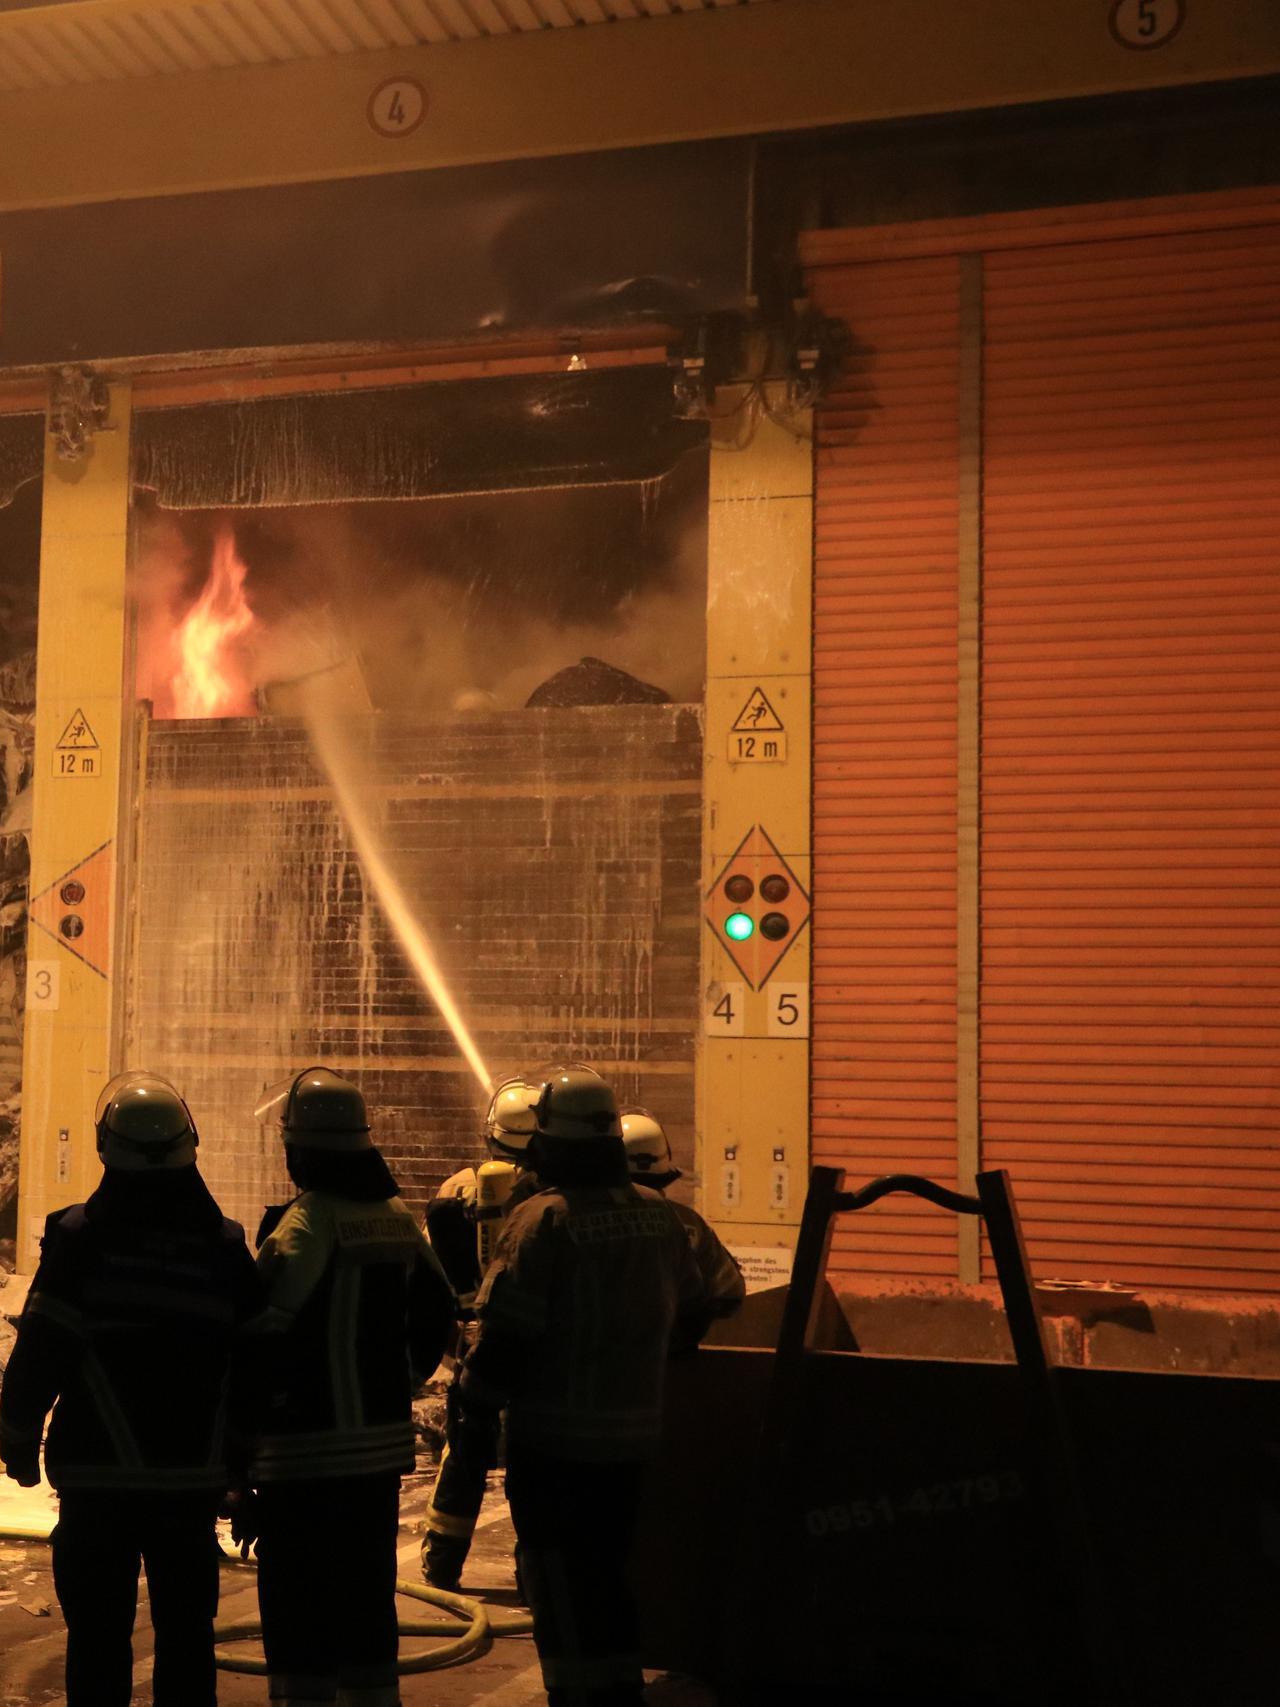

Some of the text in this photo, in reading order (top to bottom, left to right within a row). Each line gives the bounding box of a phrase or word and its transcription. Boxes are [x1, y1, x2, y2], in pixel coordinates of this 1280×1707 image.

[1138, 0, 1157, 36] 5
[387, 90, 405, 126] 4
[61, 754, 94, 773] 12 m
[738, 737, 778, 758] 12 m
[34, 970, 52, 1000] 3
[713, 992, 735, 1025] 4
[777, 993, 799, 1026] 5
